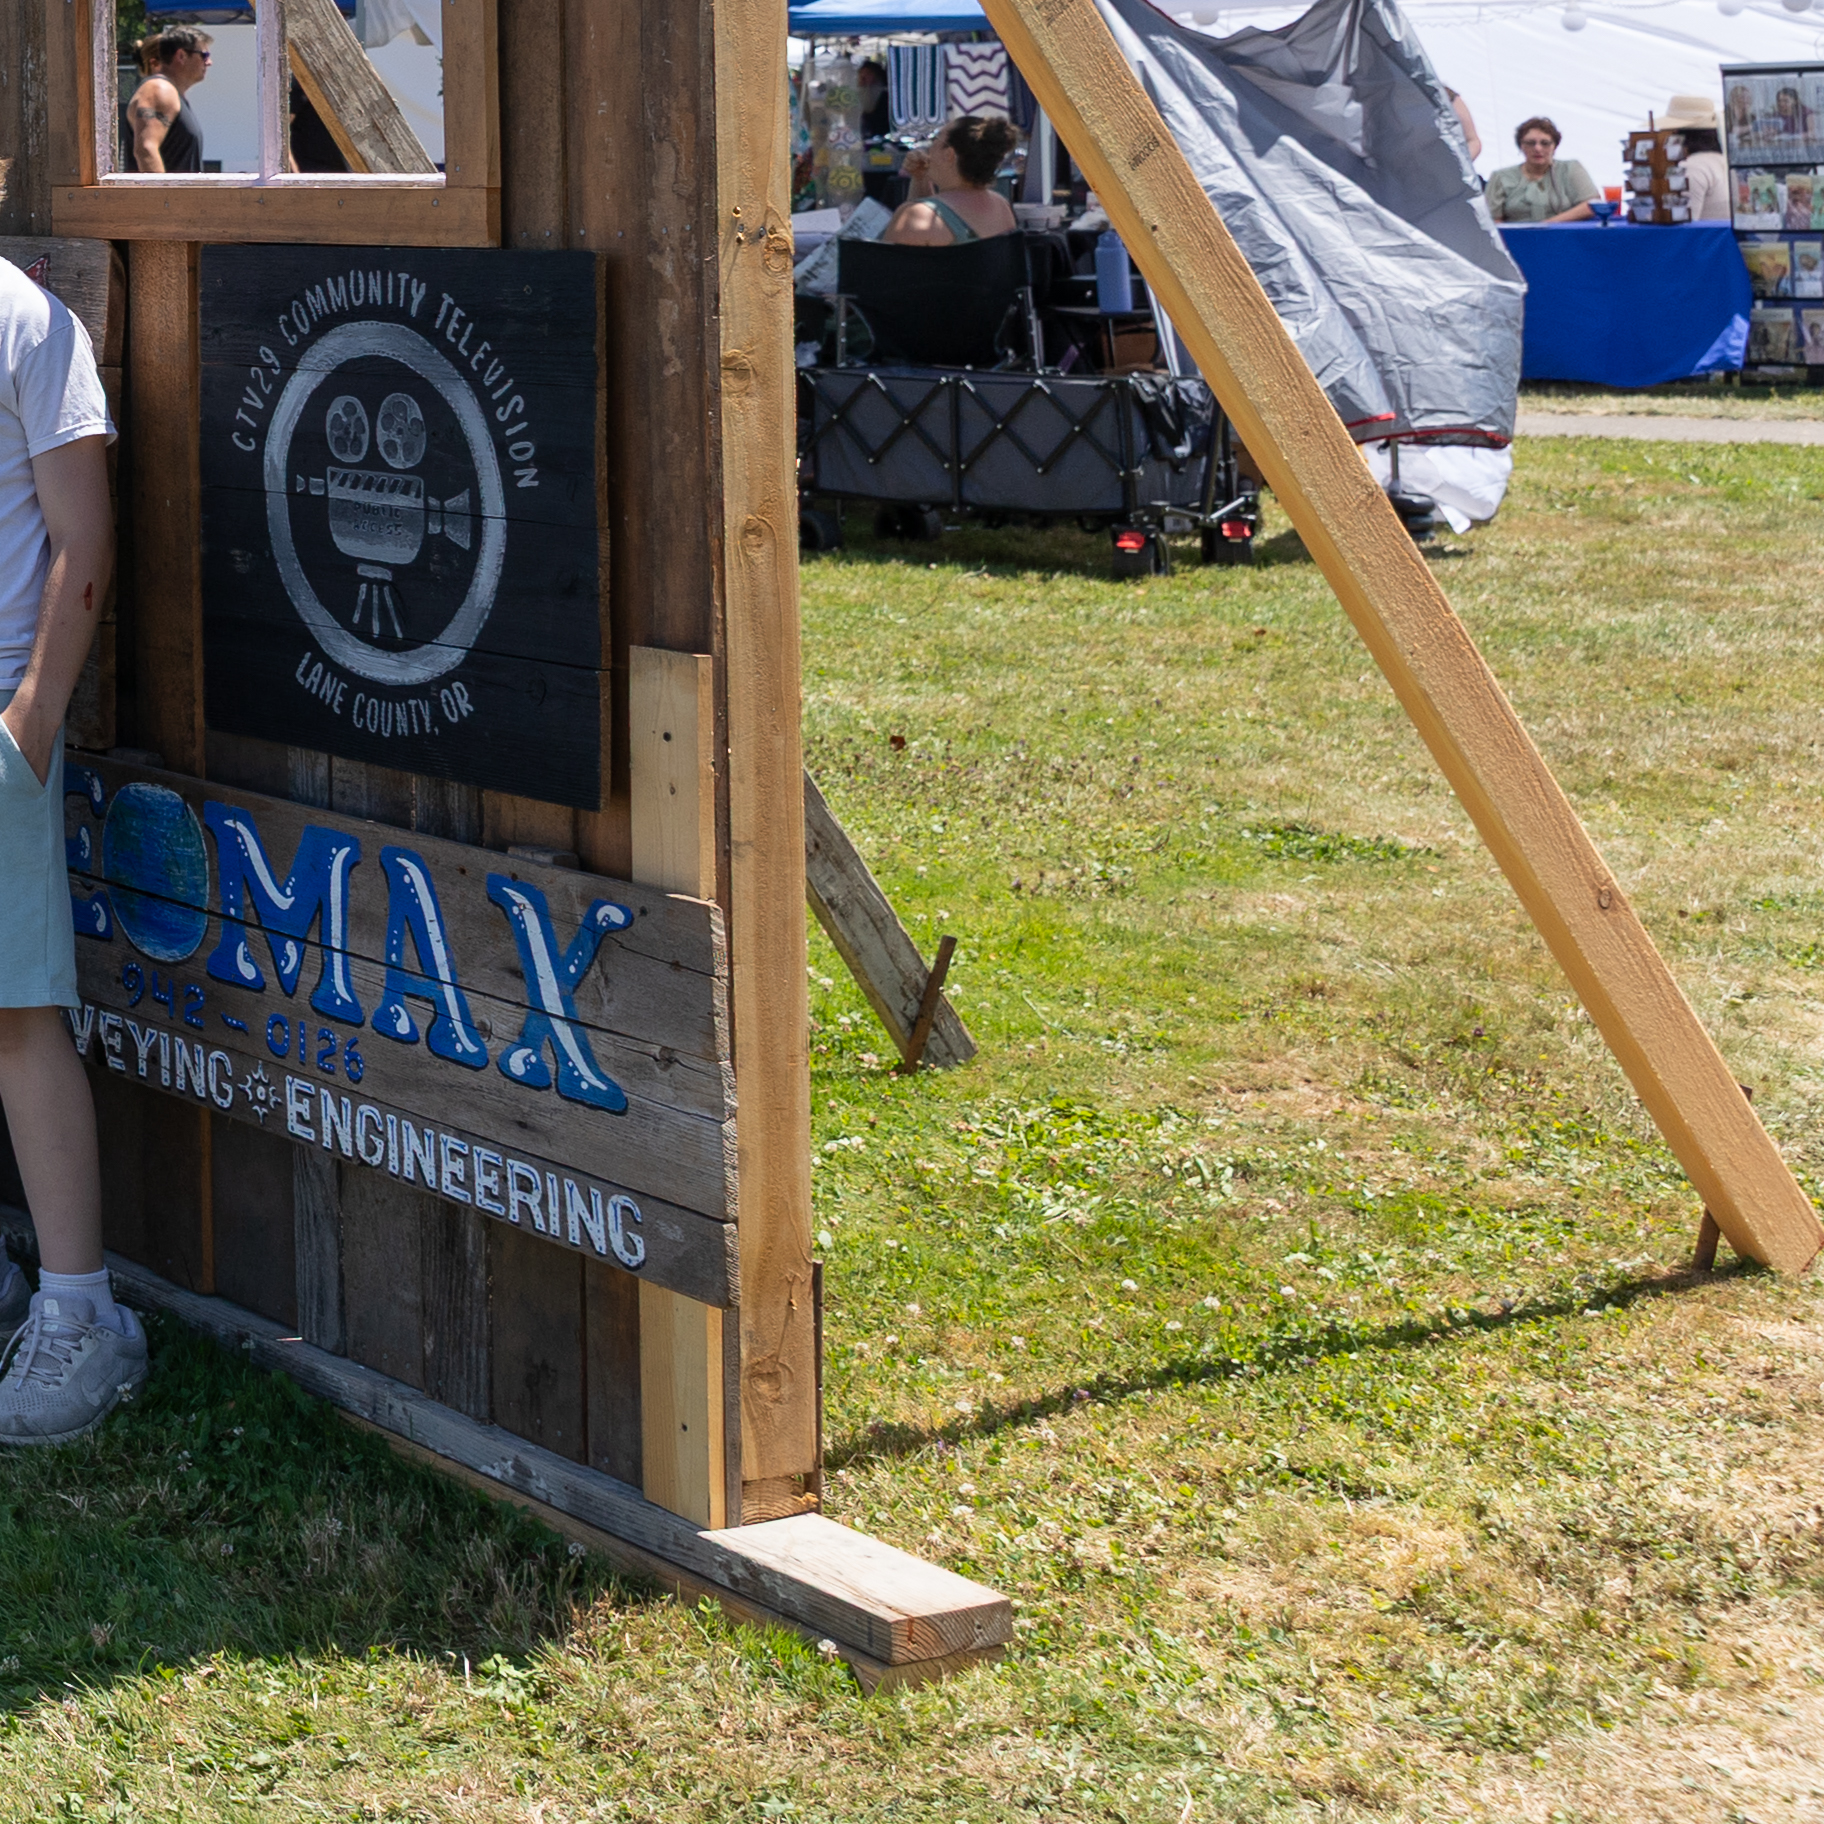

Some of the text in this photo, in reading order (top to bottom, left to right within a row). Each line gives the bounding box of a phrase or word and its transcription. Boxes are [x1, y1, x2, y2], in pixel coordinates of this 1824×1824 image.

[231, 269, 540, 489] CTV29 COMMUNITY TELEVISION
[294, 651, 346, 716] LANE
[440, 681, 476, 725] OR
[61, 1003, 646, 1269] VEYING ENGINEERING
